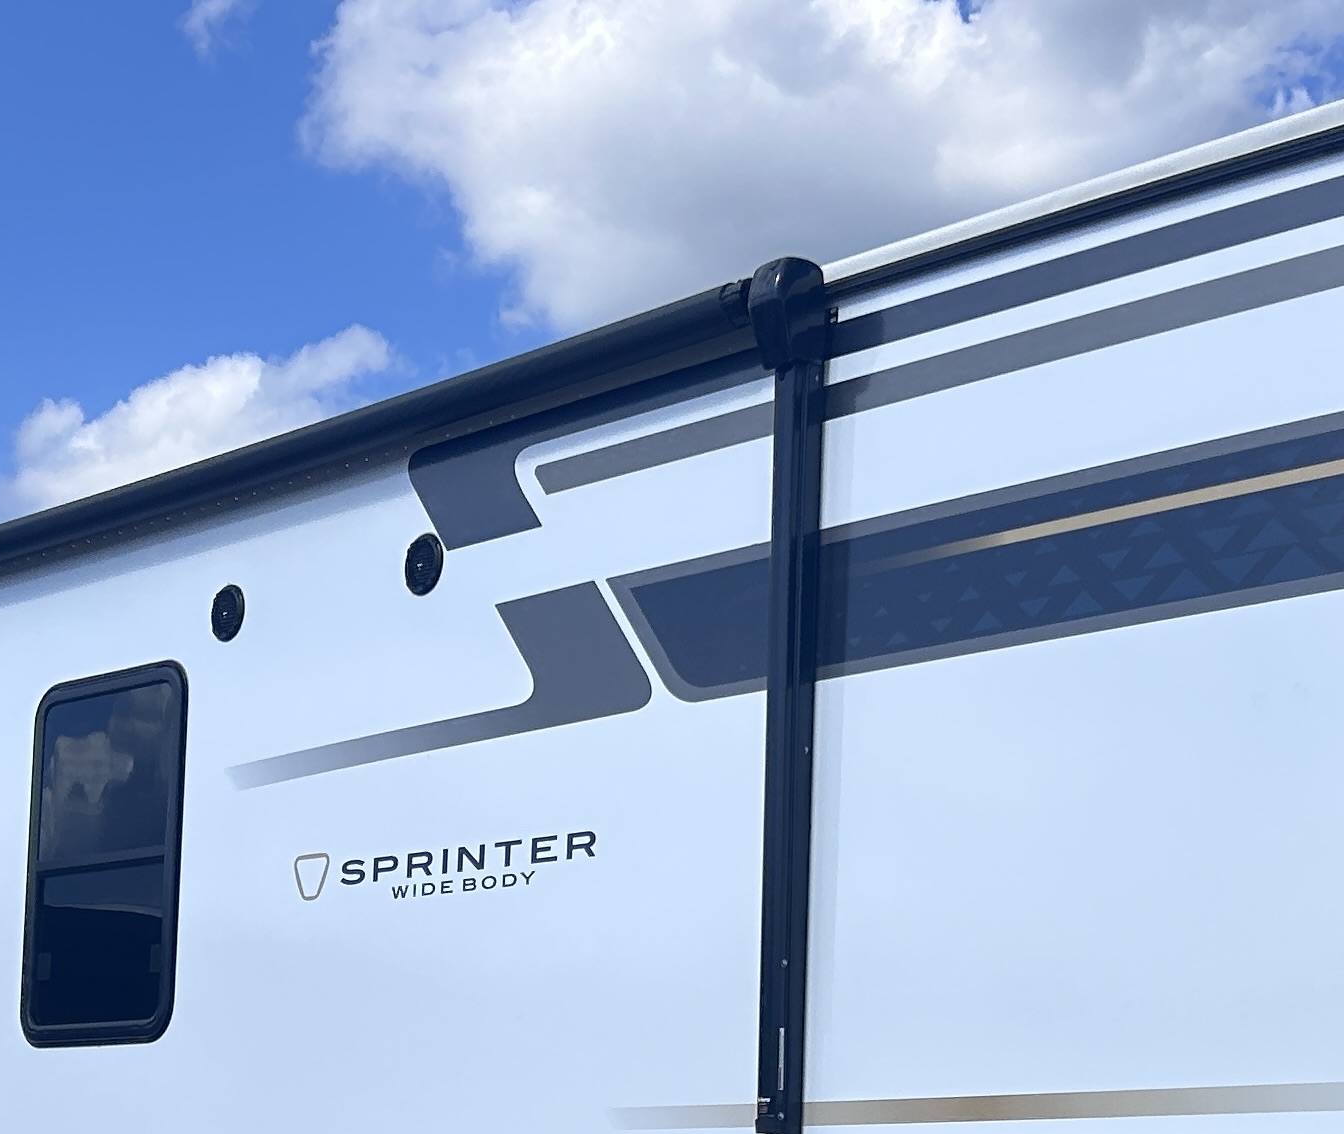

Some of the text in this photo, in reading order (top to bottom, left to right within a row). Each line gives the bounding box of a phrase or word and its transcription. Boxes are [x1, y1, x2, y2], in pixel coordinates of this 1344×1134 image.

[340, 830, 597, 885] SPRINTER
[391, 870, 536, 900] WIDE BODY
